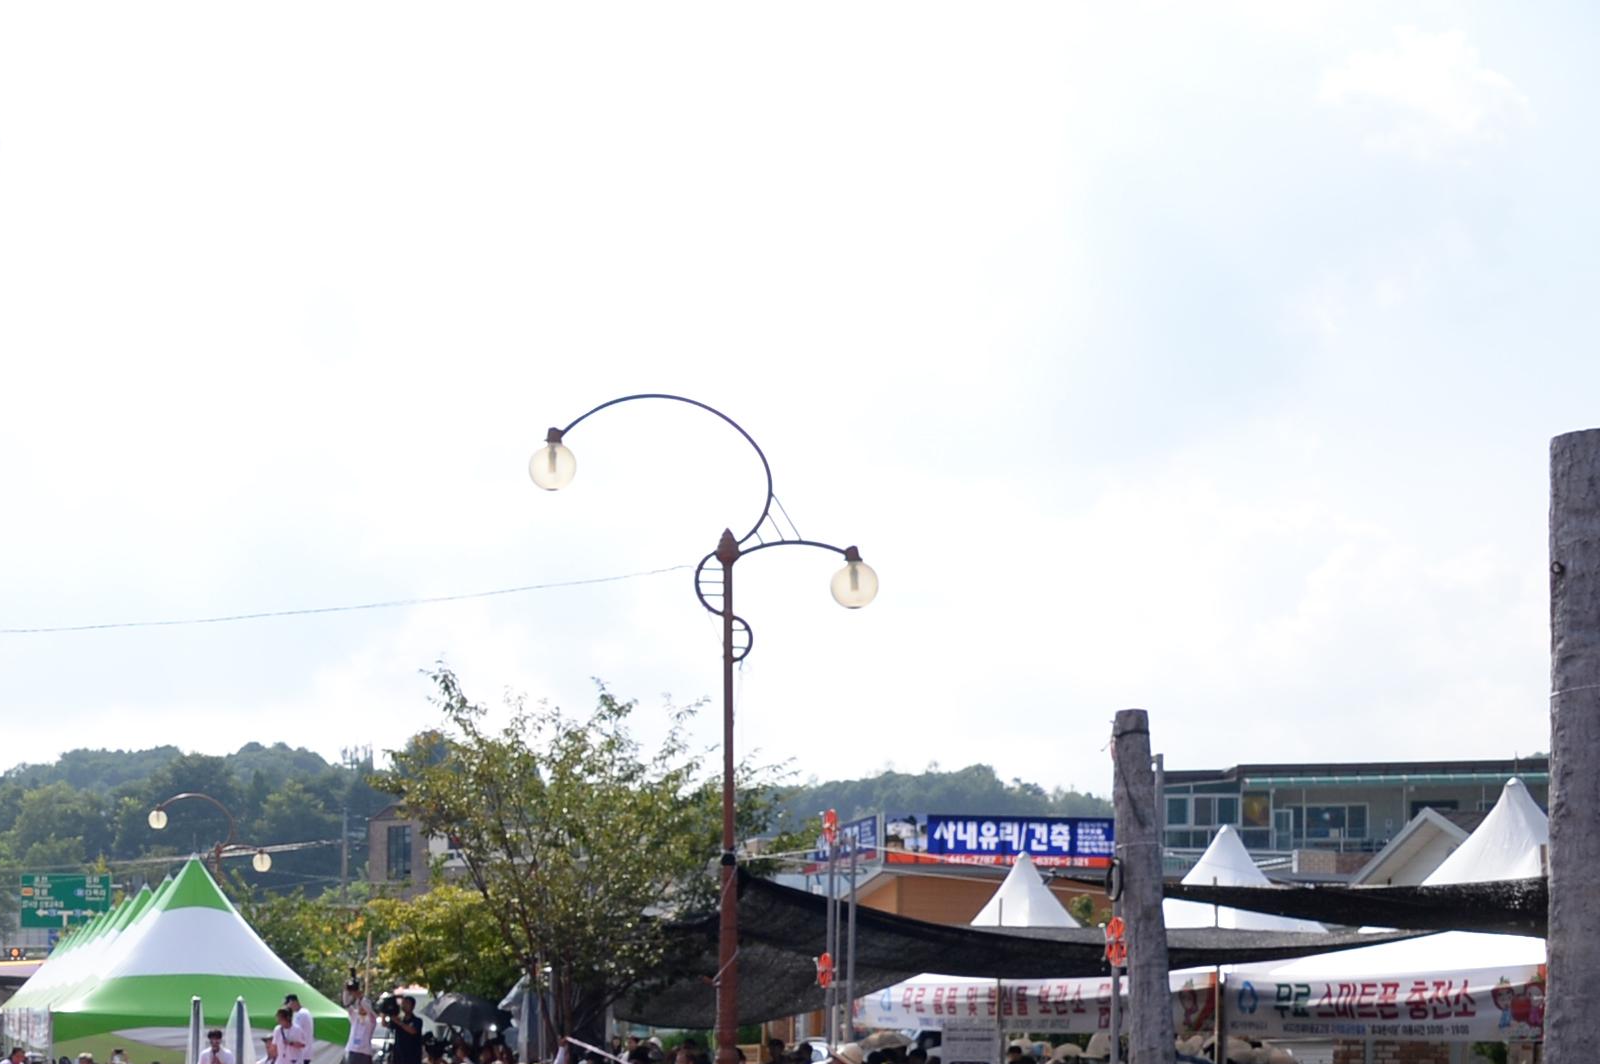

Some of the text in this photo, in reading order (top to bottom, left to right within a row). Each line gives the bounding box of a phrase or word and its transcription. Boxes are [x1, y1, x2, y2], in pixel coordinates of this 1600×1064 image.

[933, 820, 1071, 852] 사내유리/건축
[1274, 979, 1476, 1021] 무료 스마트폰 충전소
